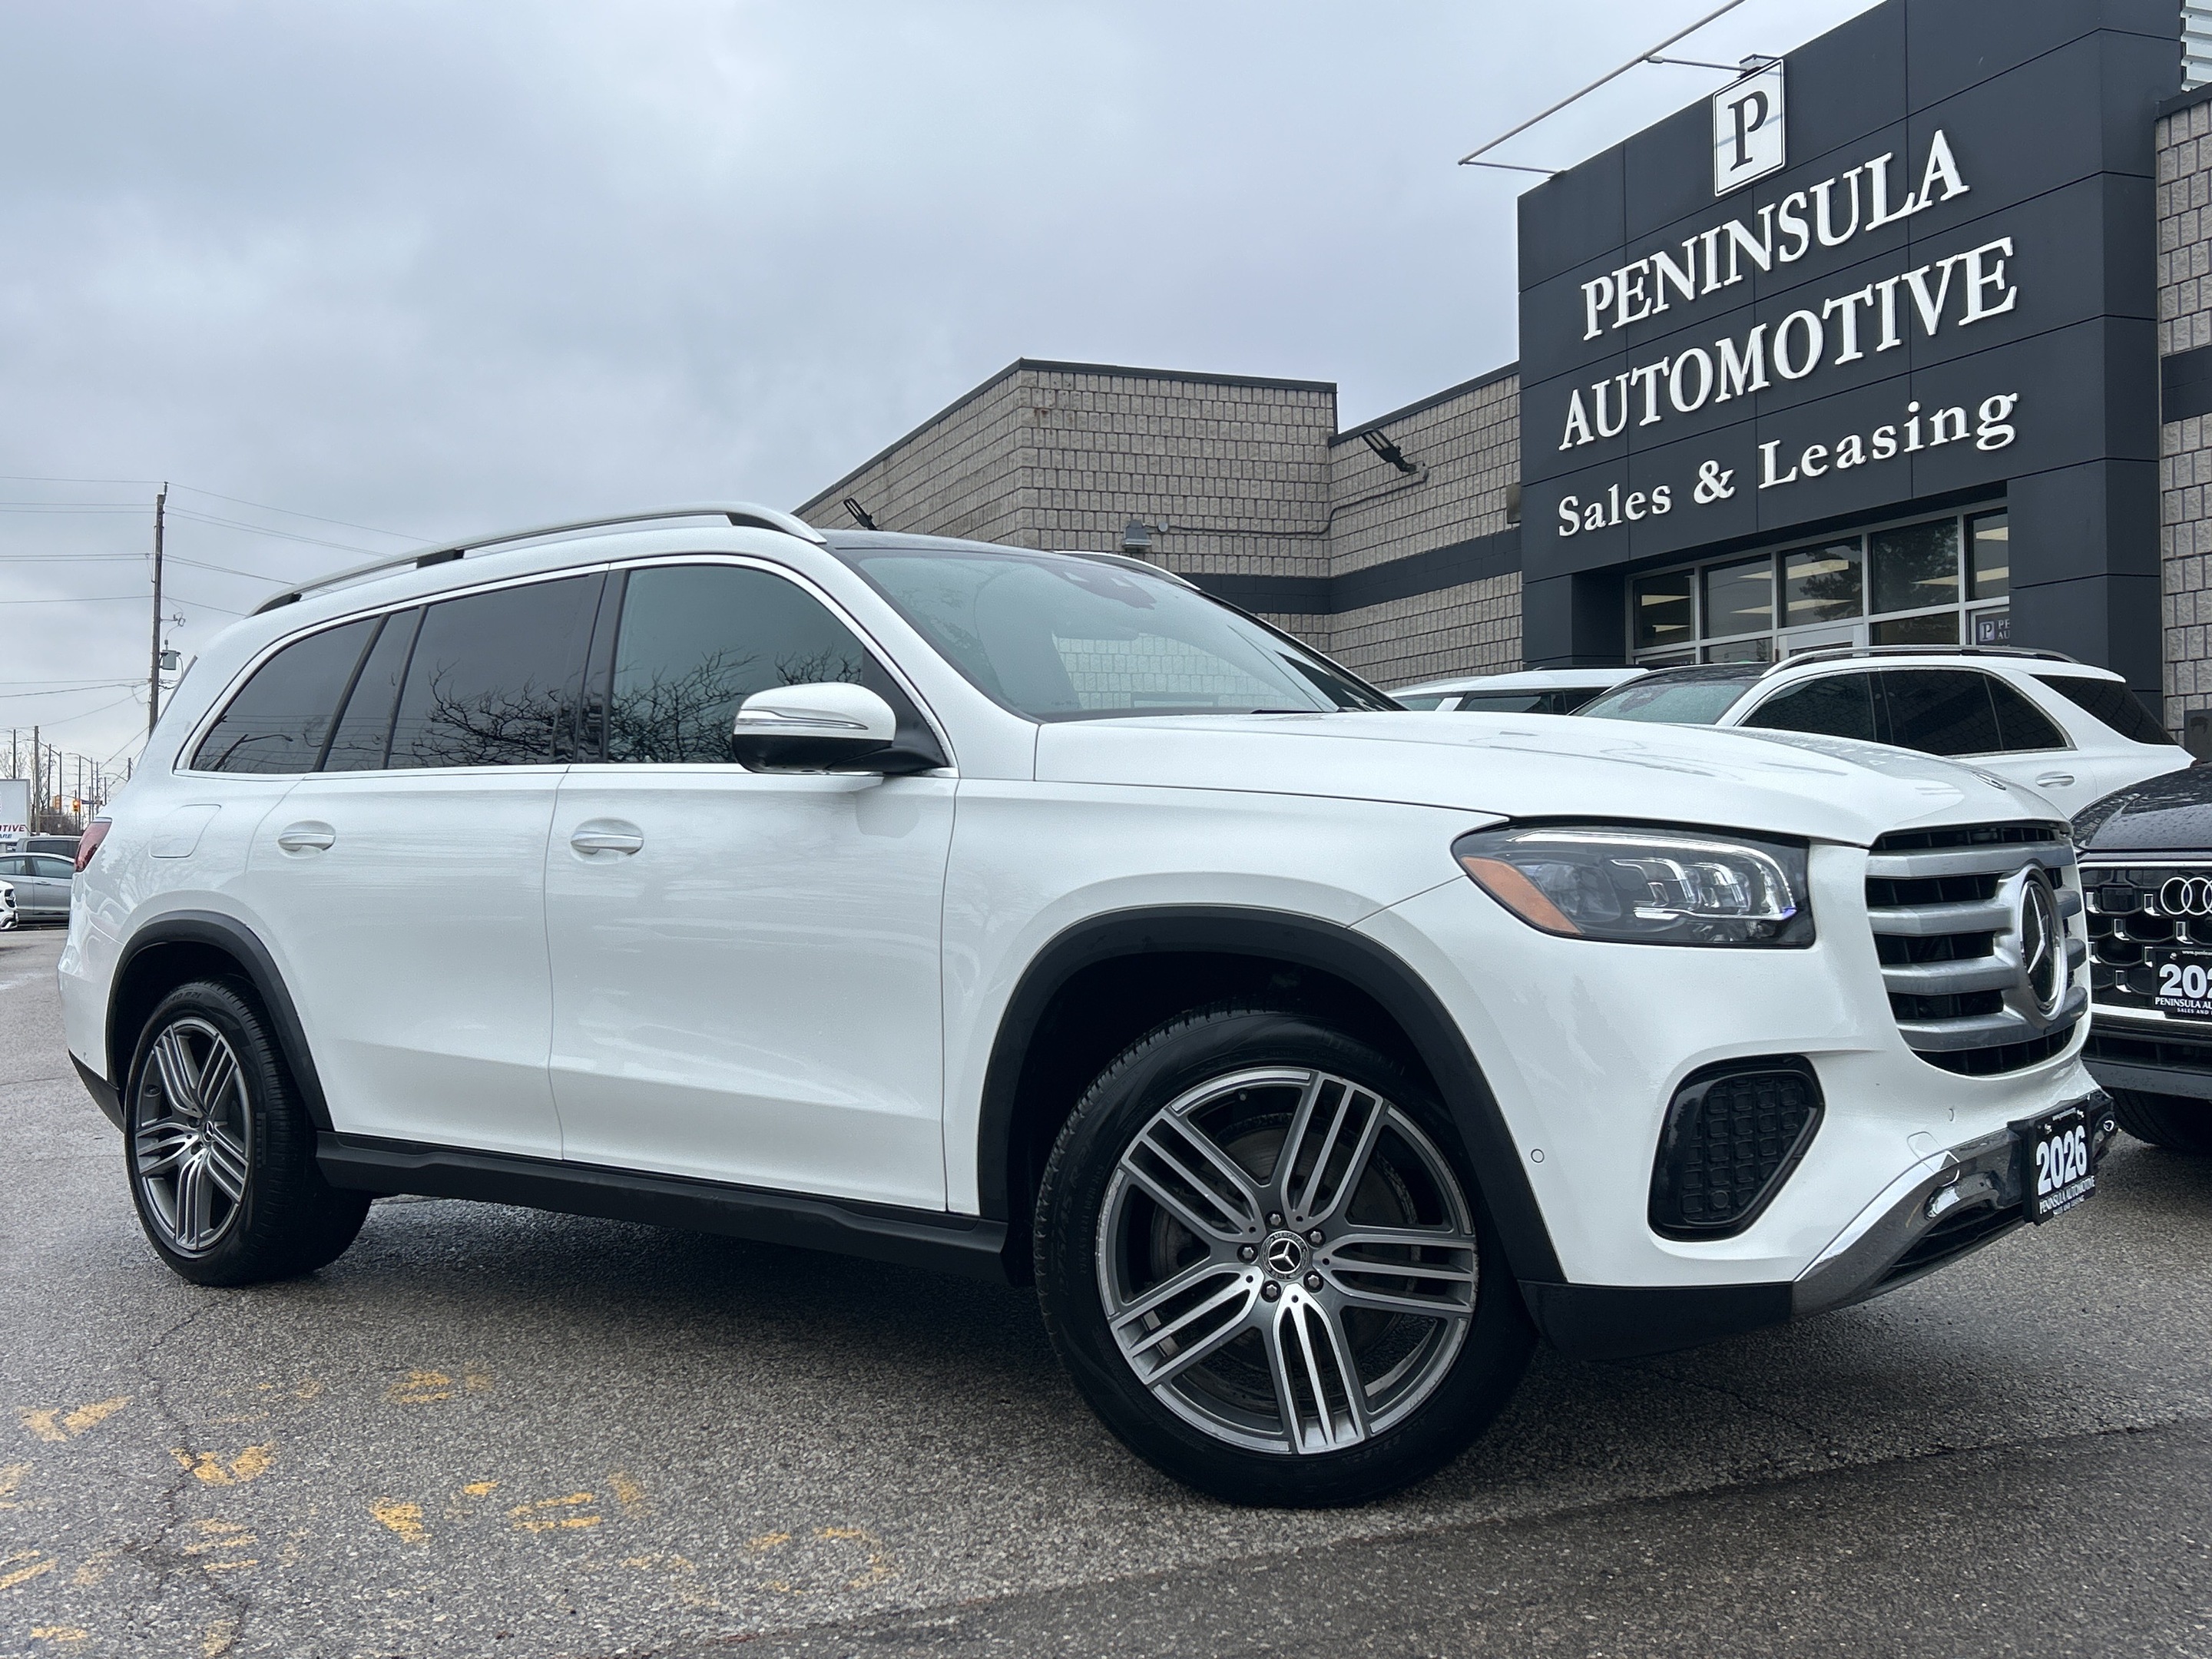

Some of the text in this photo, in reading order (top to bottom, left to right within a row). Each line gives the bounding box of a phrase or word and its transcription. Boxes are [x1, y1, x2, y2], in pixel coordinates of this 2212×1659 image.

[1727, 90, 1768, 172] P
[1581, 128, 1971, 342] PENINSULA
[1558, 236, 2018, 452] AUTOMOTIVE
[1558, 392, 2020, 538] Sales & Leasing
[1982, 622, 1993, 641] P
[2154, 997, 2201, 1009] PENINSULA
[2159, 963, 2212, 998] 20
[2036, 1125, 2088, 1196] 2026
